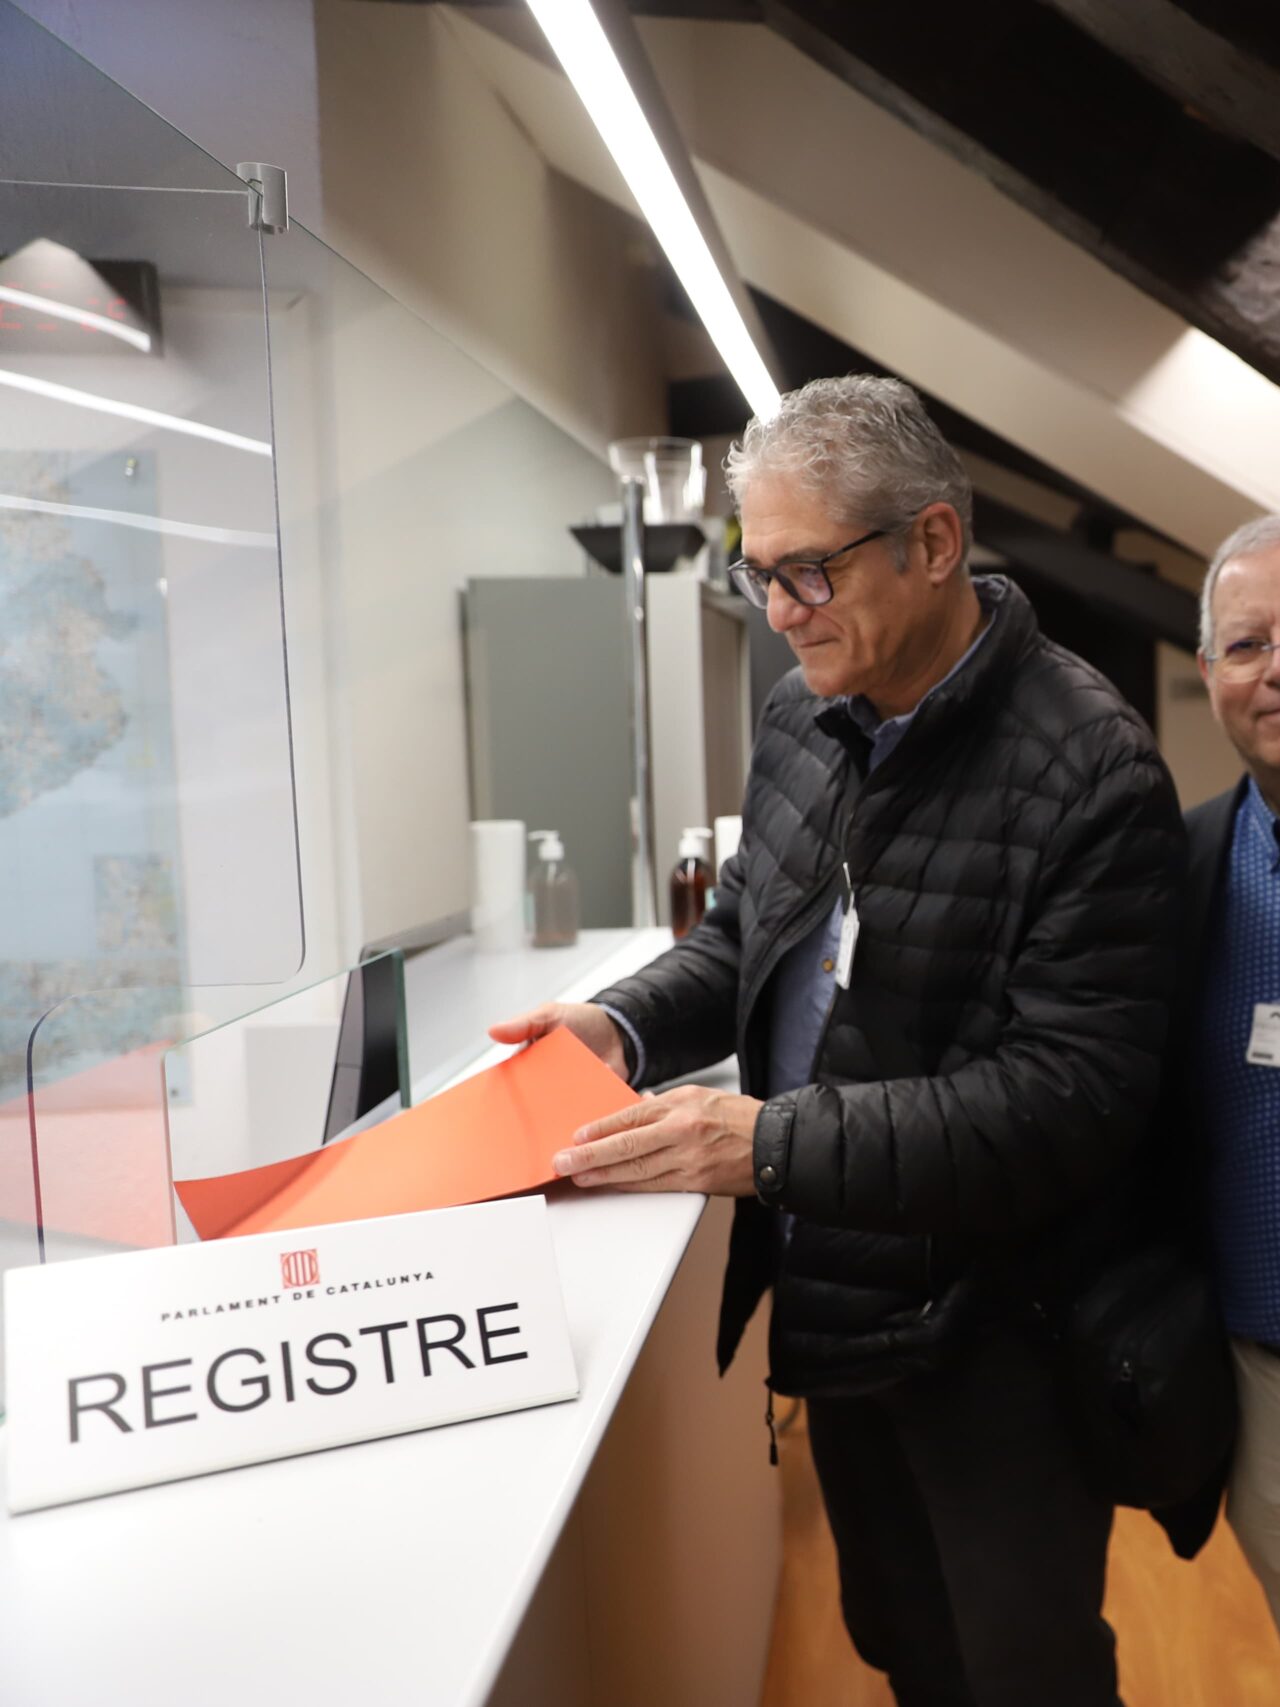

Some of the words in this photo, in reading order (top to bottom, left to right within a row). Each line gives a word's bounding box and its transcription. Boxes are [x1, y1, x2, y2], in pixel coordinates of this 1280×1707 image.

[160, 1295, 282, 1322] PARLAMENT
[292, 1290, 315, 1301] DE
[326, 1271, 435, 1296] CATALUNYA
[67, 1301, 530, 1445] REGISTRE
